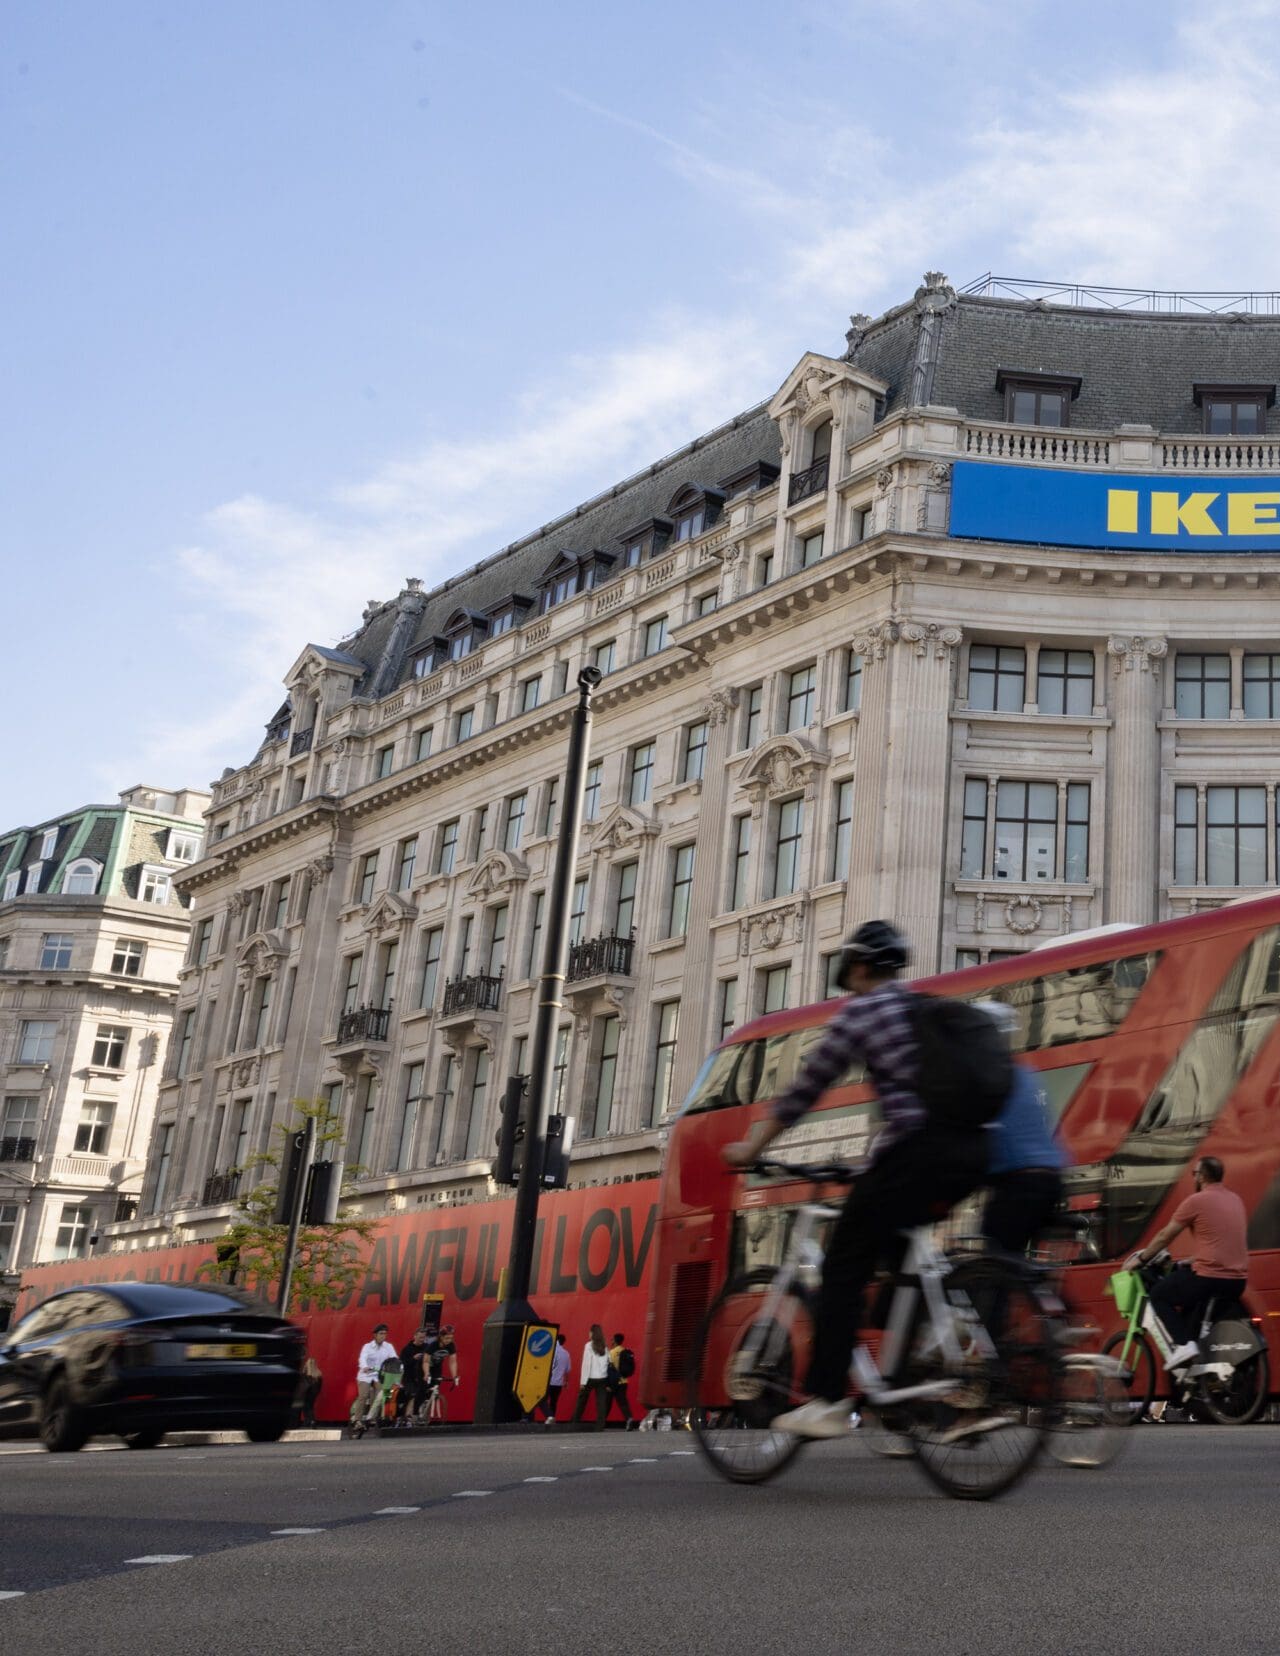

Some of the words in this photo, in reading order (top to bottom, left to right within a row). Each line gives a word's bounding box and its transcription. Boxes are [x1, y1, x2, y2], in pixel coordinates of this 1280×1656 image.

[417, 1187, 473, 1204] NIKETOWN
[360, 1223, 500, 1306] AWFUL
[551, 1204, 658, 1293] LOV
